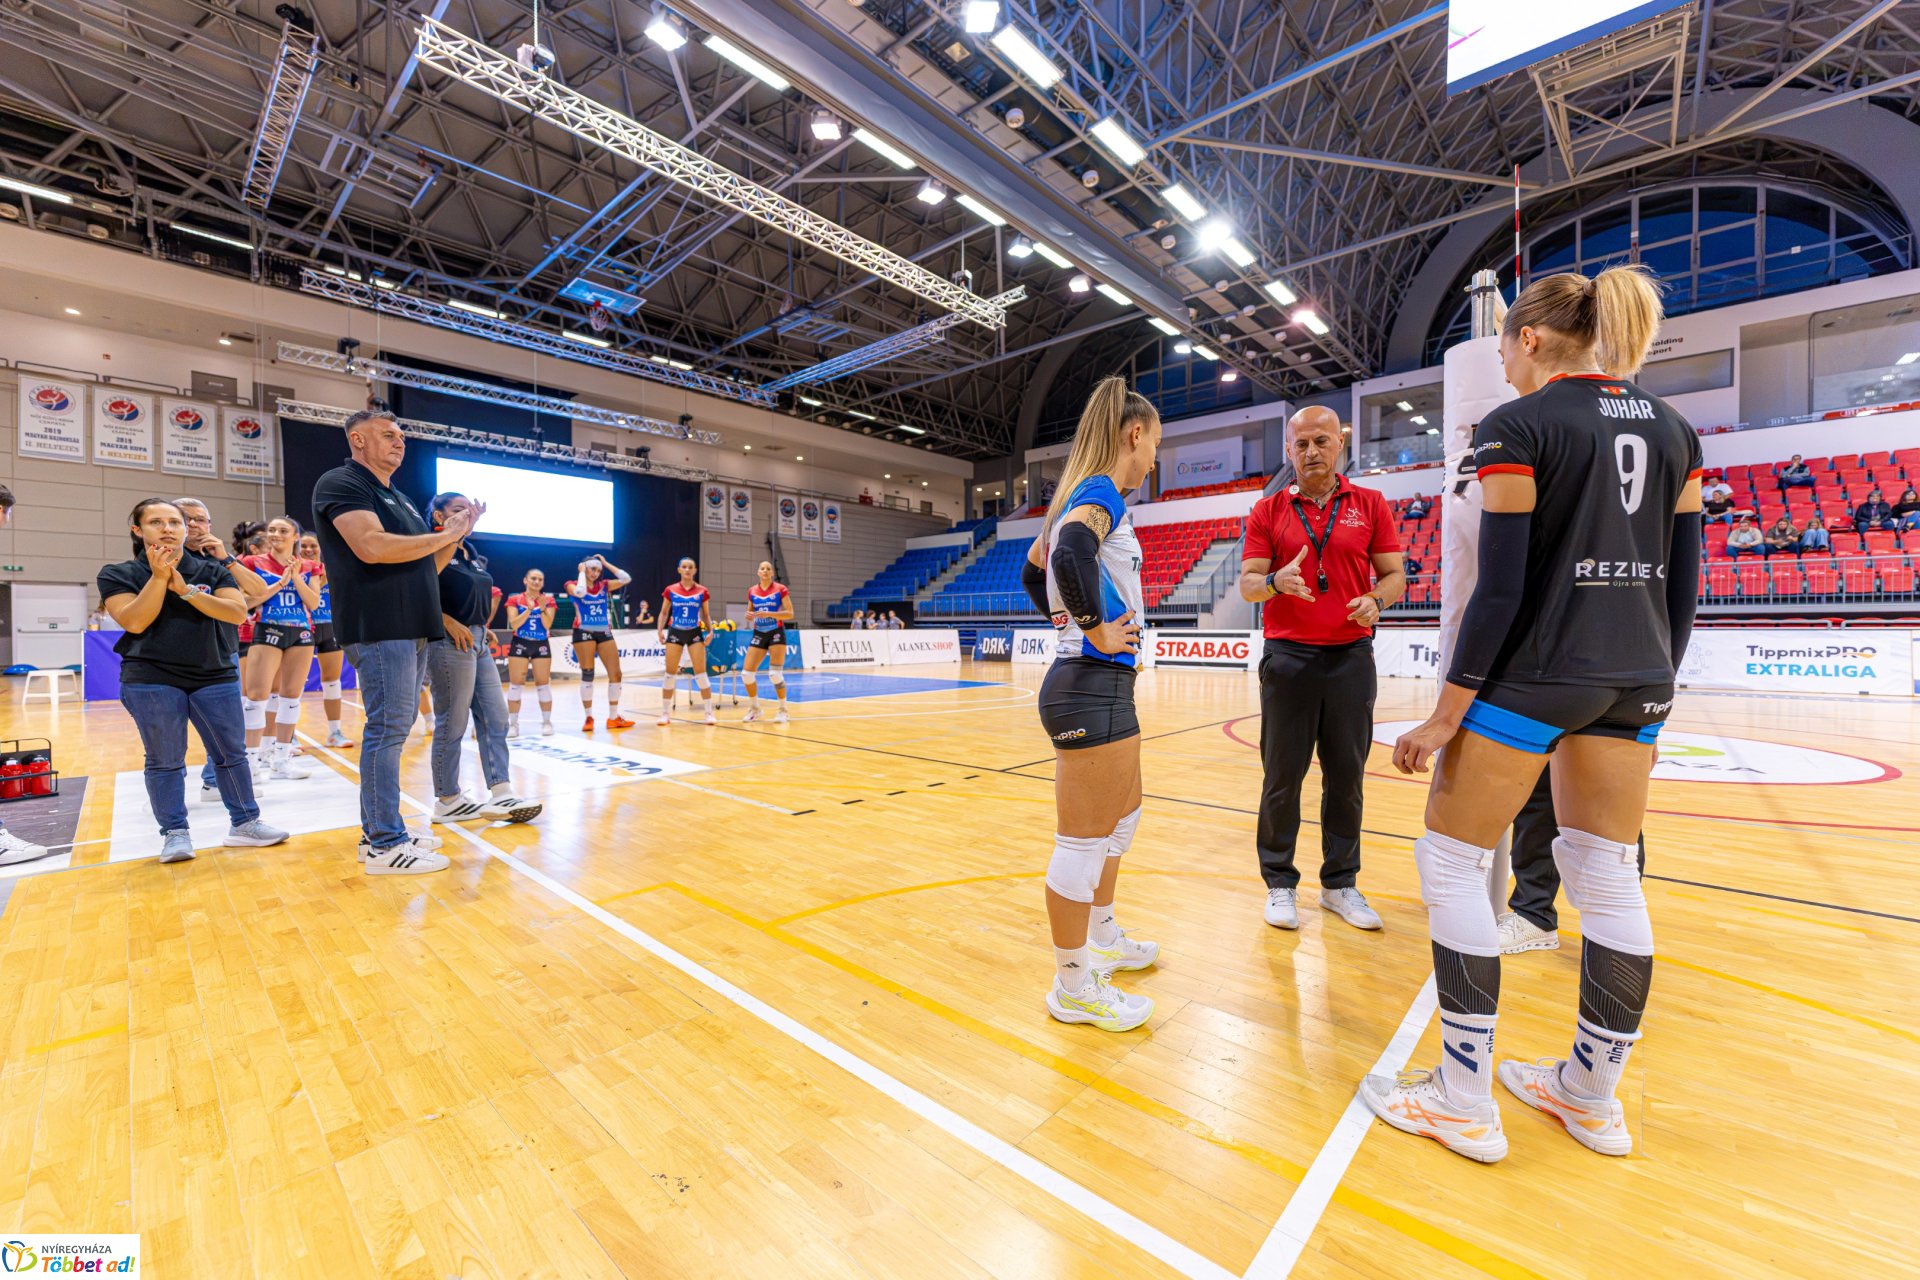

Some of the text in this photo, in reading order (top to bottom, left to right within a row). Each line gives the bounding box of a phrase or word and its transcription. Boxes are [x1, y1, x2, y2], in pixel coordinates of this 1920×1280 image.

[1598, 397, 1656, 420] JUHÁR
[1614, 434, 1648, 515] 9
[278, 592, 296, 607] 10
[590, 605, 603, 616] 24
[682, 606, 689, 618] 3
[529, 619, 537, 631] 5
[265, 634, 280, 646] 10
[820, 635, 873, 654] FATUM
[1155, 640, 1249, 660] STRABAG
[1746, 645, 1877, 660] TippmixPRO
[1746, 662, 1877, 678] EXTRALIGA
